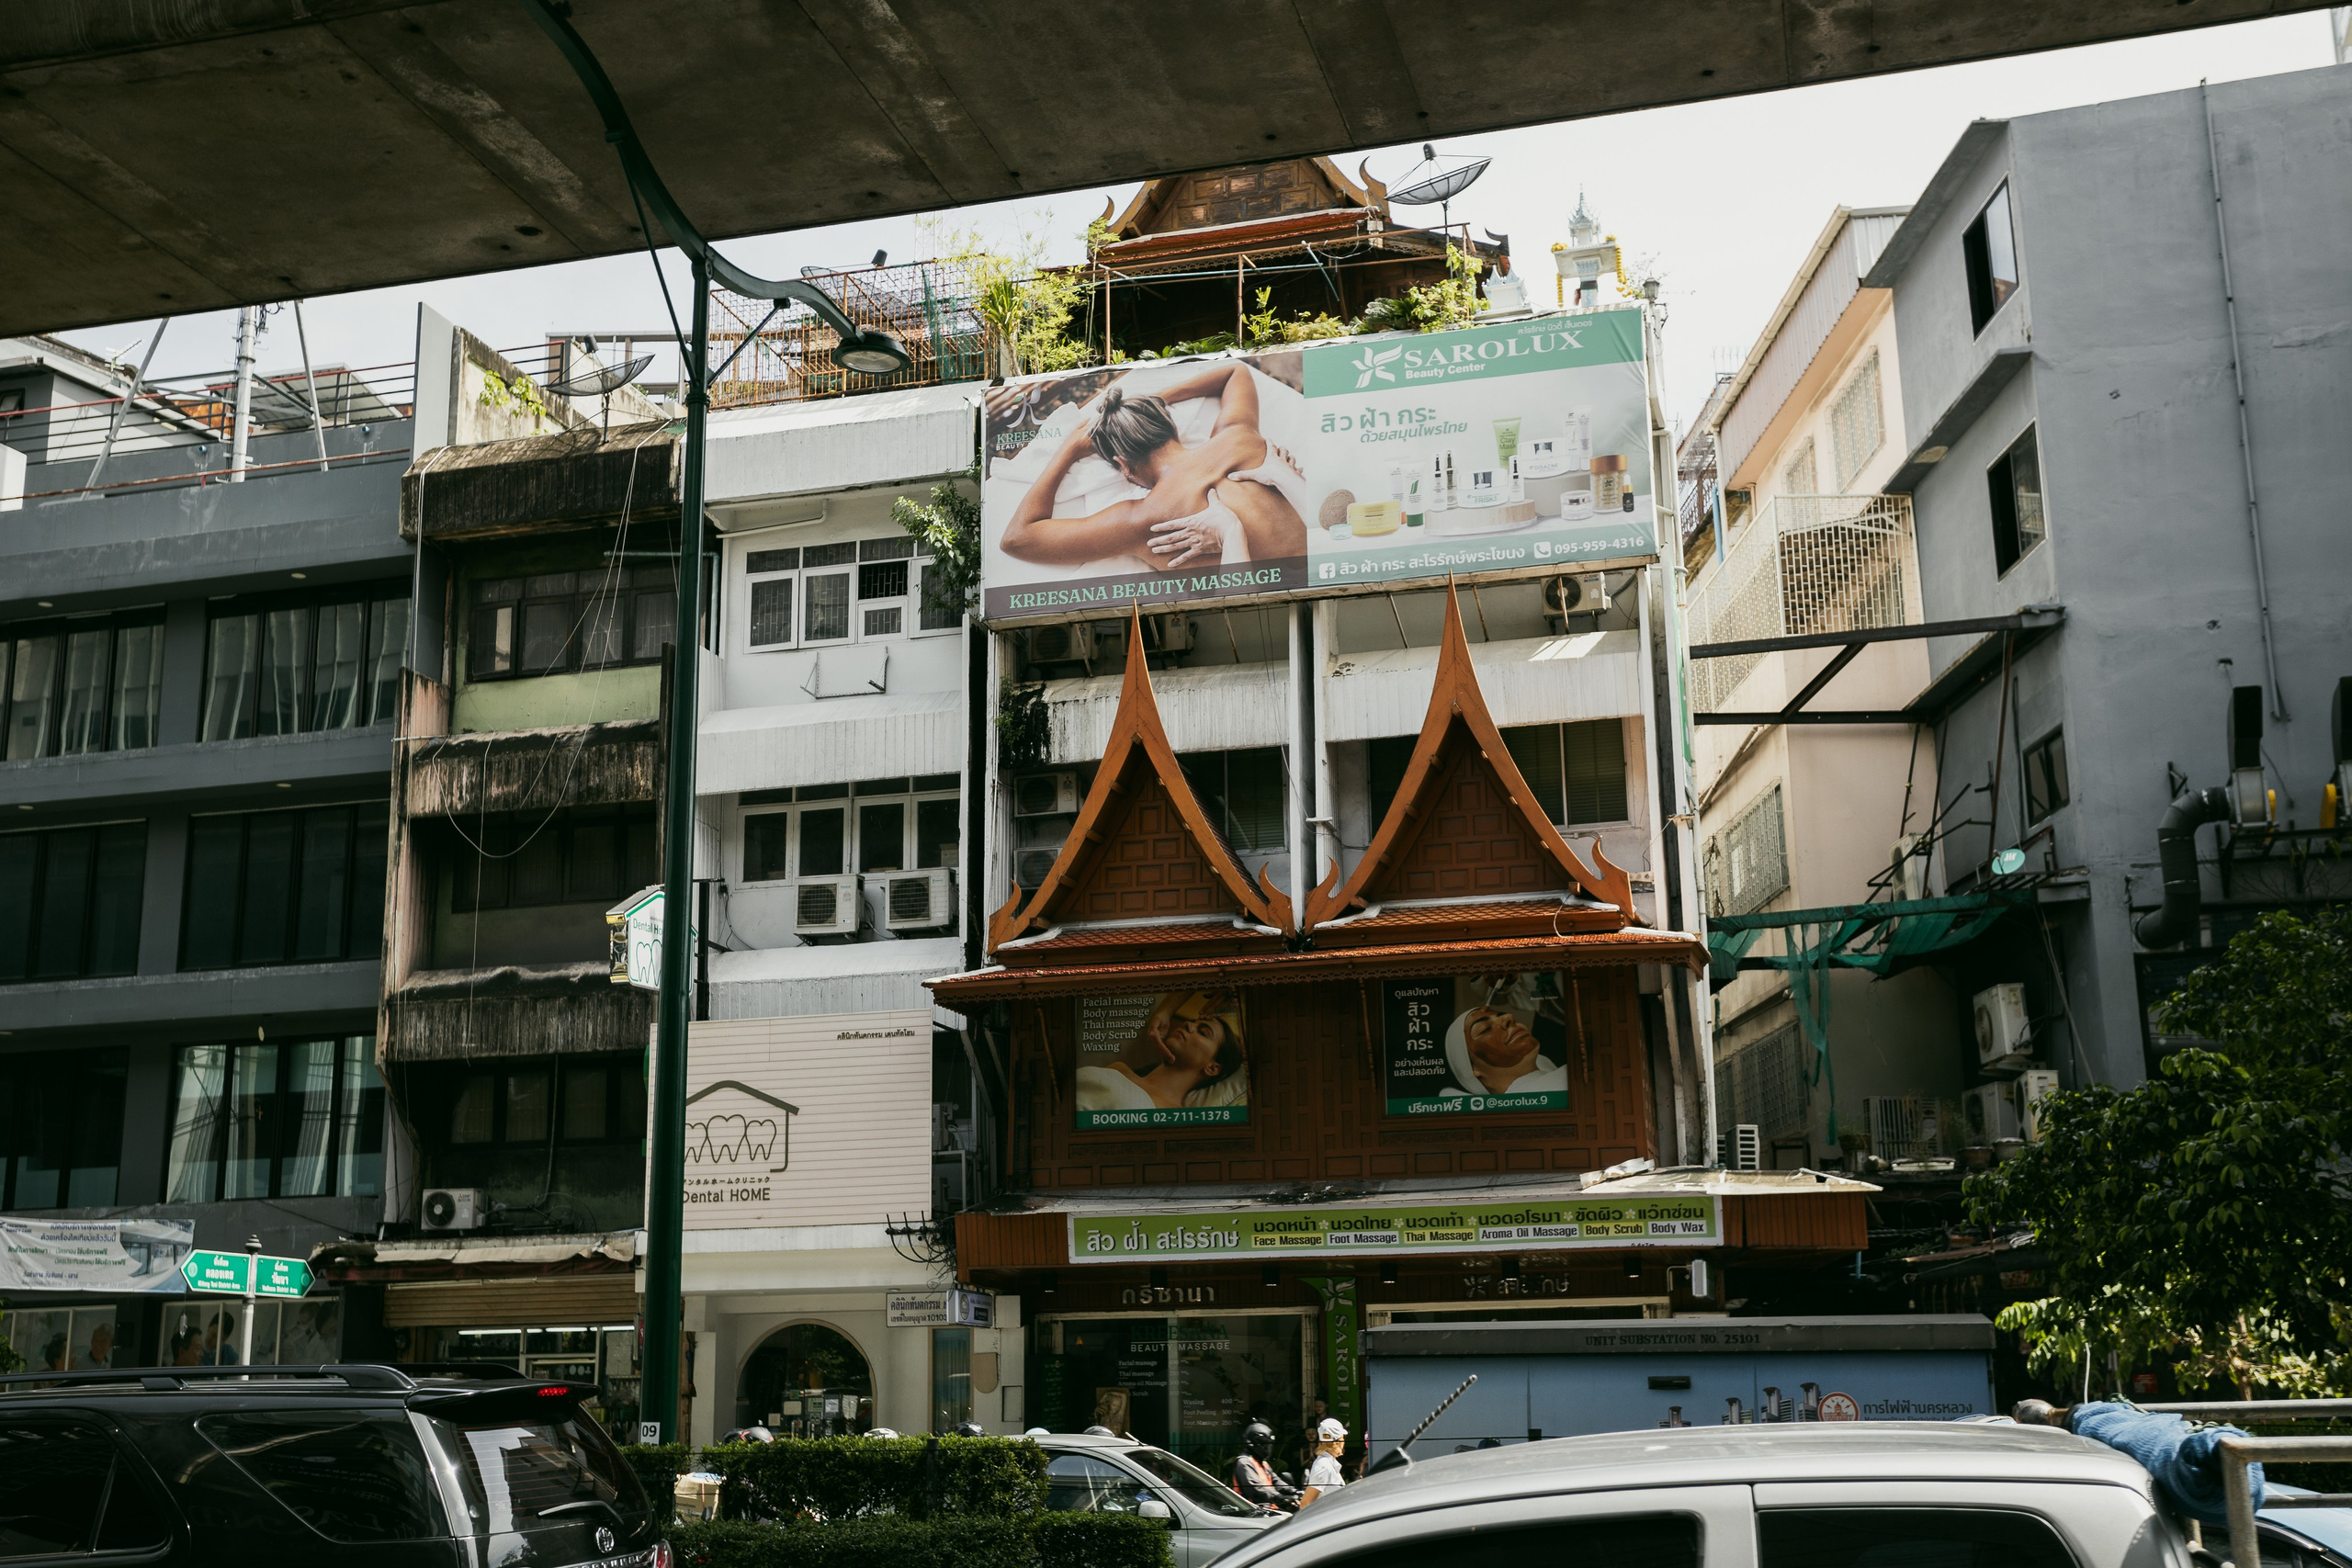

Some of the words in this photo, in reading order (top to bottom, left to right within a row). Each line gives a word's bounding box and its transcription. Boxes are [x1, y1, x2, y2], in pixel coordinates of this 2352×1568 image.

[1404, 330, 1585, 369] SAROLUX
[1406, 367, 1445, 379] Beauty
[1447, 362, 1486, 375] Center
[1320, 412, 1352, 434] สิว
[1360, 407, 1391, 431] ฝ้า
[1397, 407, 1436, 425] กระ
[996, 427, 1062, 445] KREESANA
[1360, 421, 1468, 444] ด้วยสมุนไพรไทย
[995, 441, 1025, 451] BEAUTY
[1499, 436, 1515, 445] Clay
[1554, 536, 1645, 555] 095-959-4316
[1339, 561, 1358, 575] สิว
[1361, 558, 1379, 573] ฝ้า
[1381, 558, 1406, 571] กระ
[1408, 547, 1526, 570] สะโรรักษ์พระโขนง
[1009, 586, 1109, 609] KREESANA
[1112, 578, 1188, 600] BEAUTY
[1191, 567, 1283, 592] MASSAGE
[633, 919, 652, 933] Dental
[1394, 987, 1440, 999] ดูแลปัญหา
[1083, 997, 1112, 1007] Facial
[1114, 997, 1154, 1009] massage
[1408, 1001, 1430, 1017] สิว
[1083, 1009, 1106, 1021] Body
[1108, 1008, 1150, 1019] massage
[1082, 1020, 1104, 1030] Thai
[1106, 1019, 1146, 1030] massage
[1408, 1018, 1430, 1034] ฝ้า
[837, 1031, 883, 1041] คลินิกทันตกรรม
[1082, 1032, 1106, 1043] Body
[1109, 1029, 1137, 1040] Scrub
[1082, 1042, 1120, 1053] Waxing
[1407, 1038, 1433, 1051] กระ
[1395, 1056, 1444, 1068] อย่างเห็นผล
[1394, 1066, 1446, 1077] และปลอดภัย
[1408, 1098, 1464, 1114] ปรึกษาฟรี
[1487, 1095, 1548, 1109] @sarolux.9
[1092, 1112, 1148, 1125] BOOKING
[1153, 1110, 1230, 1122] 02-711-1378
[684, 1176, 770, 1186] ンタルホームクリニック
[684, 1189, 724, 1203] Dental
[730, 1188, 770, 1201] HOME
[1254, 1216, 1317, 1233] นวดหน้า
[1330, 1215, 1392, 1231] นวดไทย
[1406, 1211, 1464, 1227] นวดเท้า
[1478, 1209, 1561, 1225] นวดอโรมา
[1576, 1206, 1623, 1223] ขัดผิว
[1087, 1229, 1115, 1251] สิว
[1124, 1221, 1148, 1251] ฝ้า
[1156, 1219, 1239, 1249] สะโรรักษ์
[1254, 1235, 1275, 1246] Face
[1279, 1234, 1322, 1247] Massage
[1329, 1233, 1351, 1245] Foot
[1354, 1232, 1397, 1246] Massage
[1405, 1231, 1426, 1241] Thai
[1430, 1230, 1473, 1243] Massage
[1481, 1228, 1512, 1239] Aroma
[1517, 1226, 1529, 1237] Oil
[1532, 1225, 1577, 1238] Massage
[1586, 1224, 1611, 1236] Body
[1614, 1223, 1643, 1234] Scrub
[1651, 1223, 1676, 1234] Body
[1680, 1222, 1704, 1232] Wax
[890, 1296, 941, 1311] คลินิกทันตกรรม
[1130, 1344, 1173, 1352] BEAUTY
[1178, 1342, 1230, 1351] MASSAGE
[1585, 1336, 1616, 1346] UNIT
[1620, 1335, 1696, 1345] SUBSTATION
[1701, 1334, 1719, 1344] NO.
[1724, 1334, 1761, 1344] 25101
[1335, 1314, 1351, 1430] SAROLU
[1863, 1399, 1973, 1414] การไฟฟ้านครหลวง
[642, 1425, 657, 1438] 09
